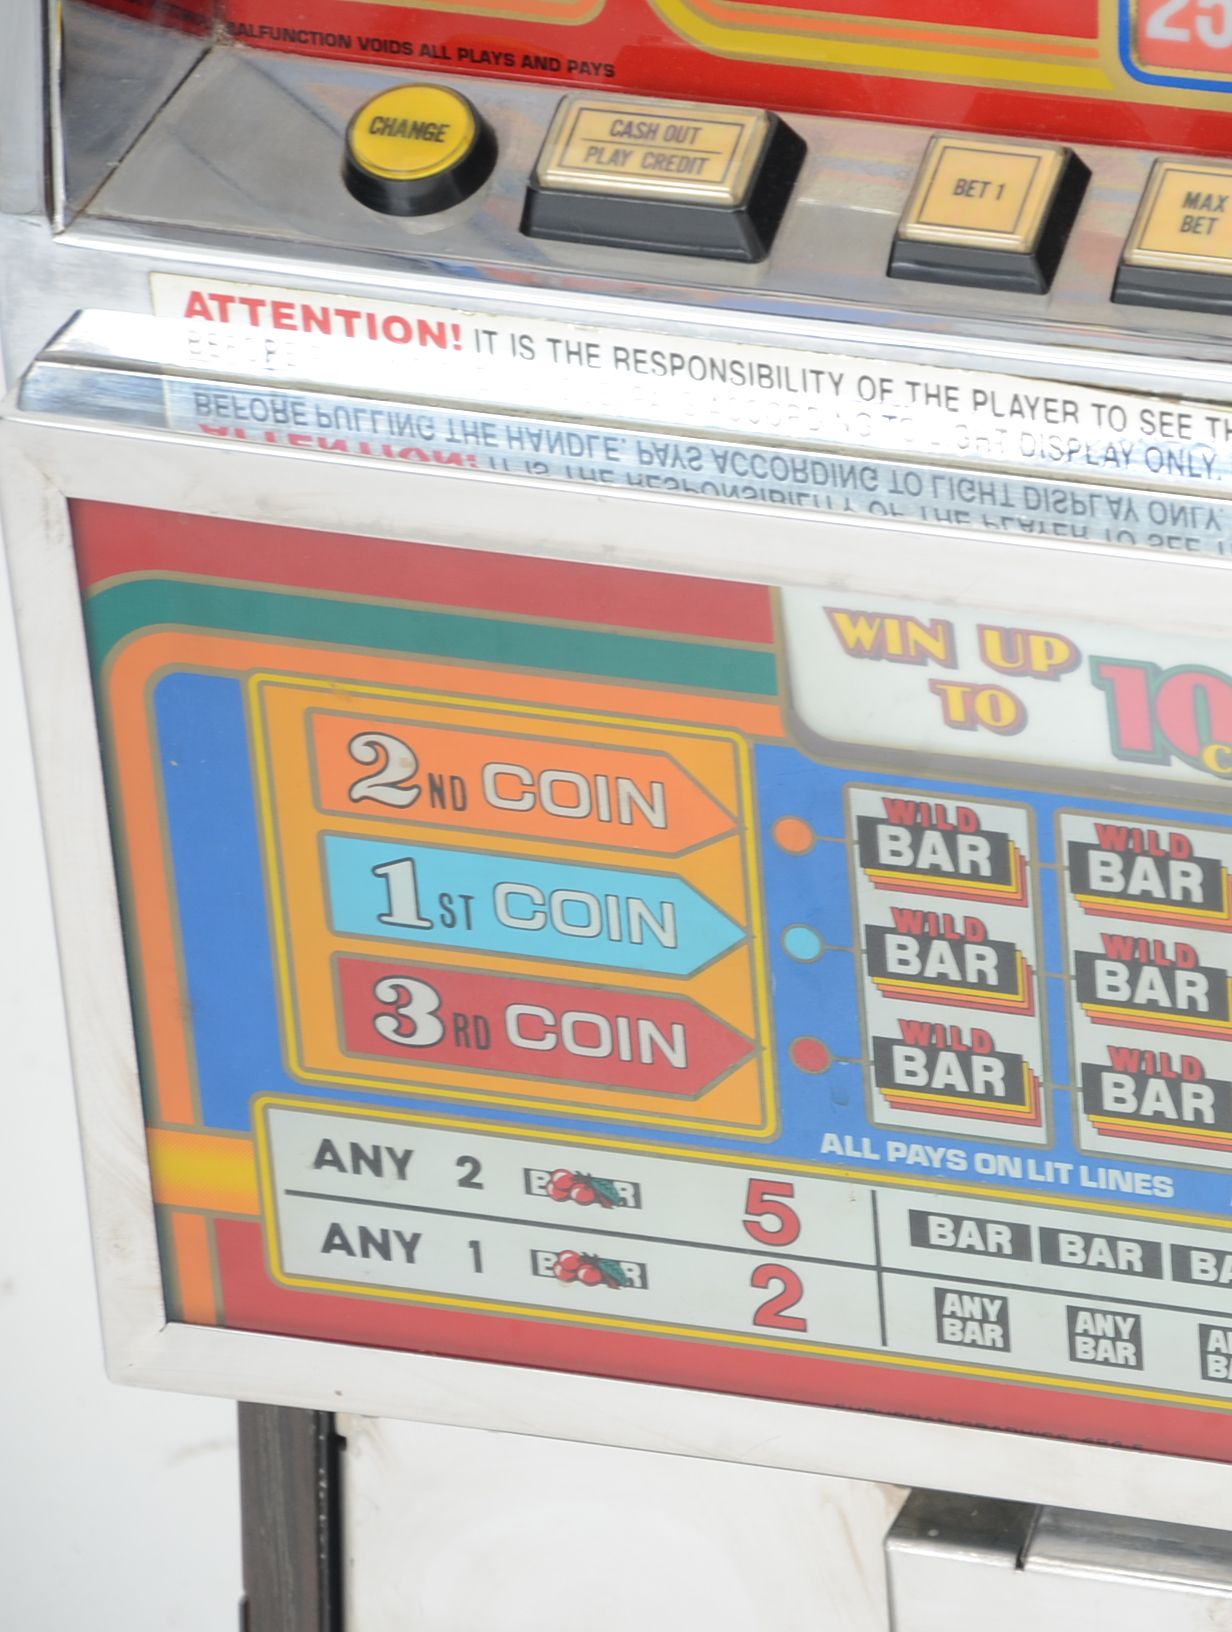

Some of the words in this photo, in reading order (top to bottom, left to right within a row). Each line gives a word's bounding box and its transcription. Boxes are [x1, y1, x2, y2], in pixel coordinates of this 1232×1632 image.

[358, 36, 413, 56] VOIDS
[420, 43, 452, 61] ALL
[457, 46, 516, 68] PLAYS
[521, 53, 561, 72] AND
[566, 58, 616, 78] PAYS
[369, 115, 450, 143] CHANGE
[609, 119, 660, 140] CASH
[663, 124, 703, 145] OUT
[584, 145, 633, 167] PLAY
[640, 151, 710, 175] CREDIT
[953, 177, 990, 198] BET
[995, 180, 1006, 200] 1
[1182, 189, 1230, 214] MAX
[1179, 213, 1220, 237] BET
[184, 291, 462, 350] ATTENTION!
[474, 329, 499, 355] IT
[511, 334, 535, 360] IS
[547, 337, 602, 369] THE
[613, 345, 844, 397] RESPONSIBILITY
[857, 375, 893, 402] OF
[905, 381, 959, 412] THE
[972, 388, 1079, 425] PLAYER
[1091, 403, 1127, 432] TO
[1140, 408, 1192, 440] SEE
[826, 607, 957, 668] WIN
[977, 623, 1082, 681] UP
[930, 679, 1027, 736] TO
[481, 761, 668, 830] COIN
[882, 797, 980, 834] WILD
[876, 825, 993, 878] BAR
[1095, 823, 1193, 860] WILD
[1087, 851, 1204, 904] BAR
[492, 881, 679, 950] COIN
[889, 906, 988, 942] WILD
[884, 933, 999, 986] BAR
[1100, 933, 1200, 969] WILD
[1094, 960, 1209, 1012] BAR
[504, 1002, 689, 1069] COIN
[897, 1018, 994, 1054] WILD
[892, 1045, 1007, 1098] BAR
[1106, 1045, 1205, 1081] WILD
[1100, 1072, 1216, 1125] BAR
[820, 1132, 879, 1160] ALL
[886, 1139, 967, 1170] PAYS
[974, 1149, 1020, 1177] ON
[1025, 1155, 1074, 1183] LIT
[1079, 1163, 1174, 1198] LINES
[313, 1137, 414, 1181] ANY
[455, 1155, 484, 1190] 2
[742, 1178, 801, 1247] 5
[928, 1215, 1013, 1254] BAR
[1059, 1233, 1144, 1272] BAR
[321, 1222, 422, 1264] ANY
[468, 1240, 484, 1273] 1
[750, 1263, 807, 1333] 2
[942, 1292, 1002, 1321] ANY
[1075, 1310, 1135, 1340] ANY
[943, 1319, 1004, 1348] BAR
[1075, 1337, 1137, 1367] BAR
